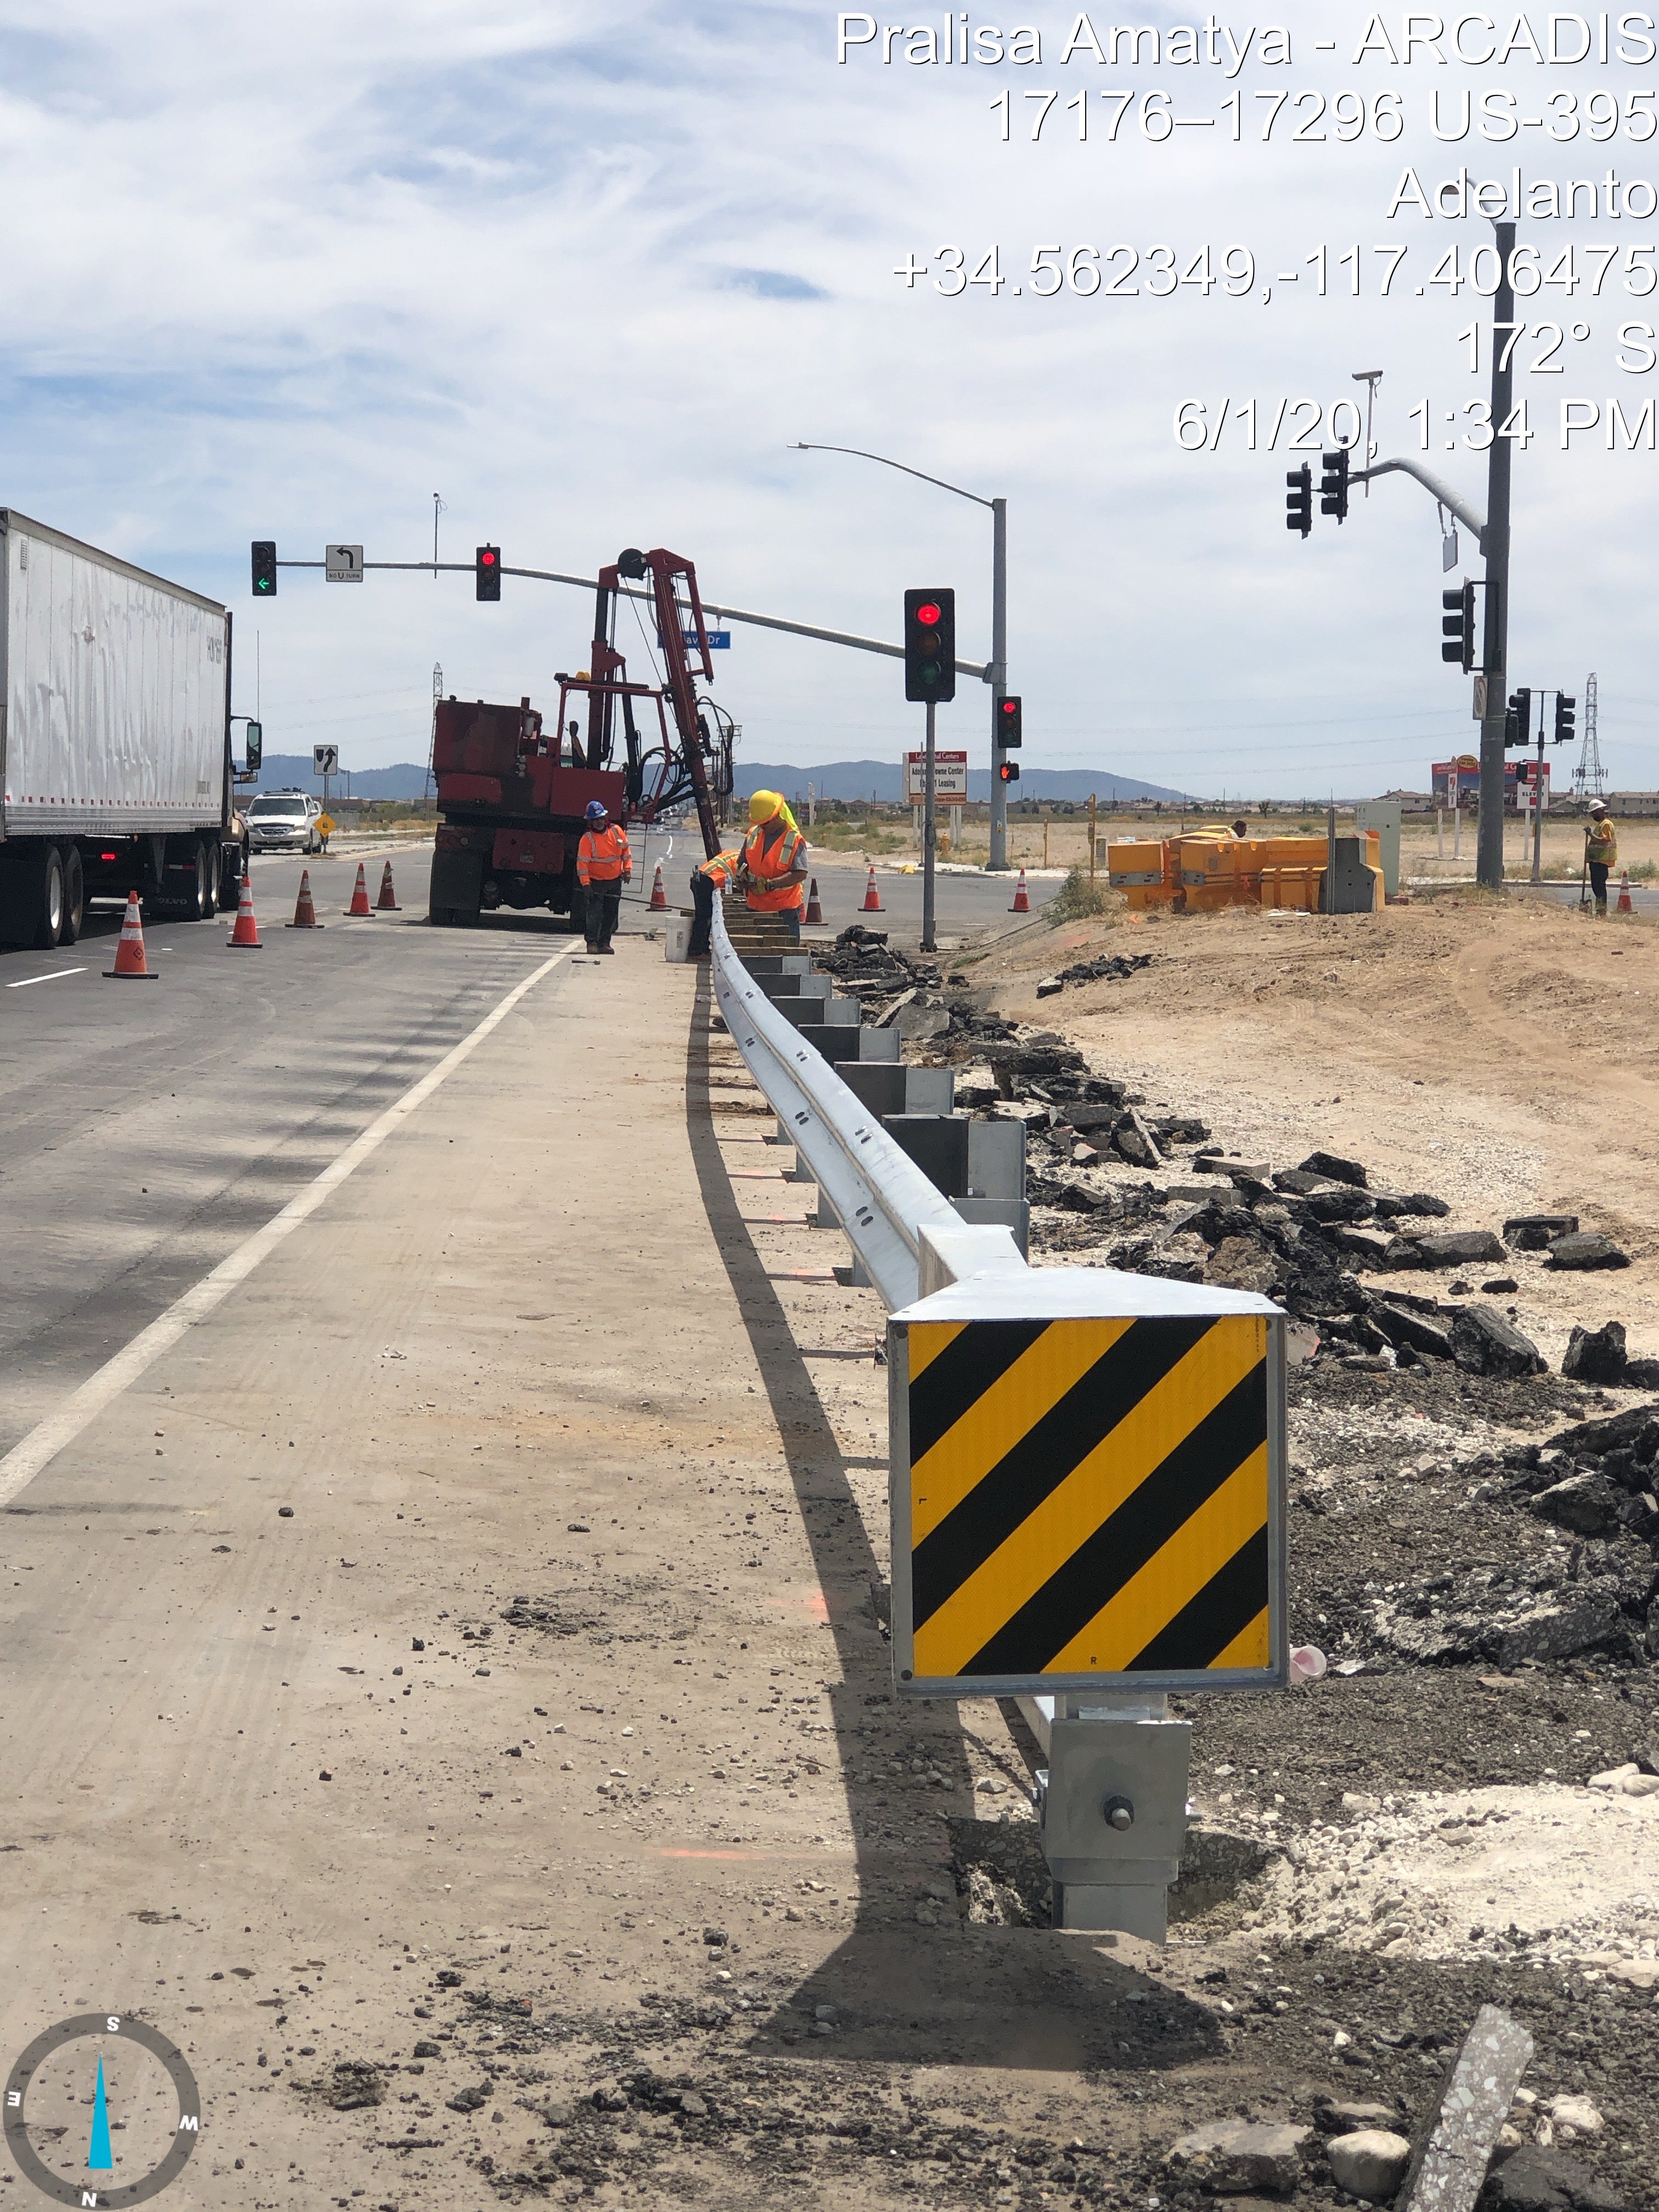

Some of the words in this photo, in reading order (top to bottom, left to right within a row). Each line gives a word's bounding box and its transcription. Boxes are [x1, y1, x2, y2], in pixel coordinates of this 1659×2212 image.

[708, 635, 720, 644] Dr
[947, 767, 964, 775] Center
[938, 778, 956, 789] Leasing
[1091, 1656, 1097, 1665] R
